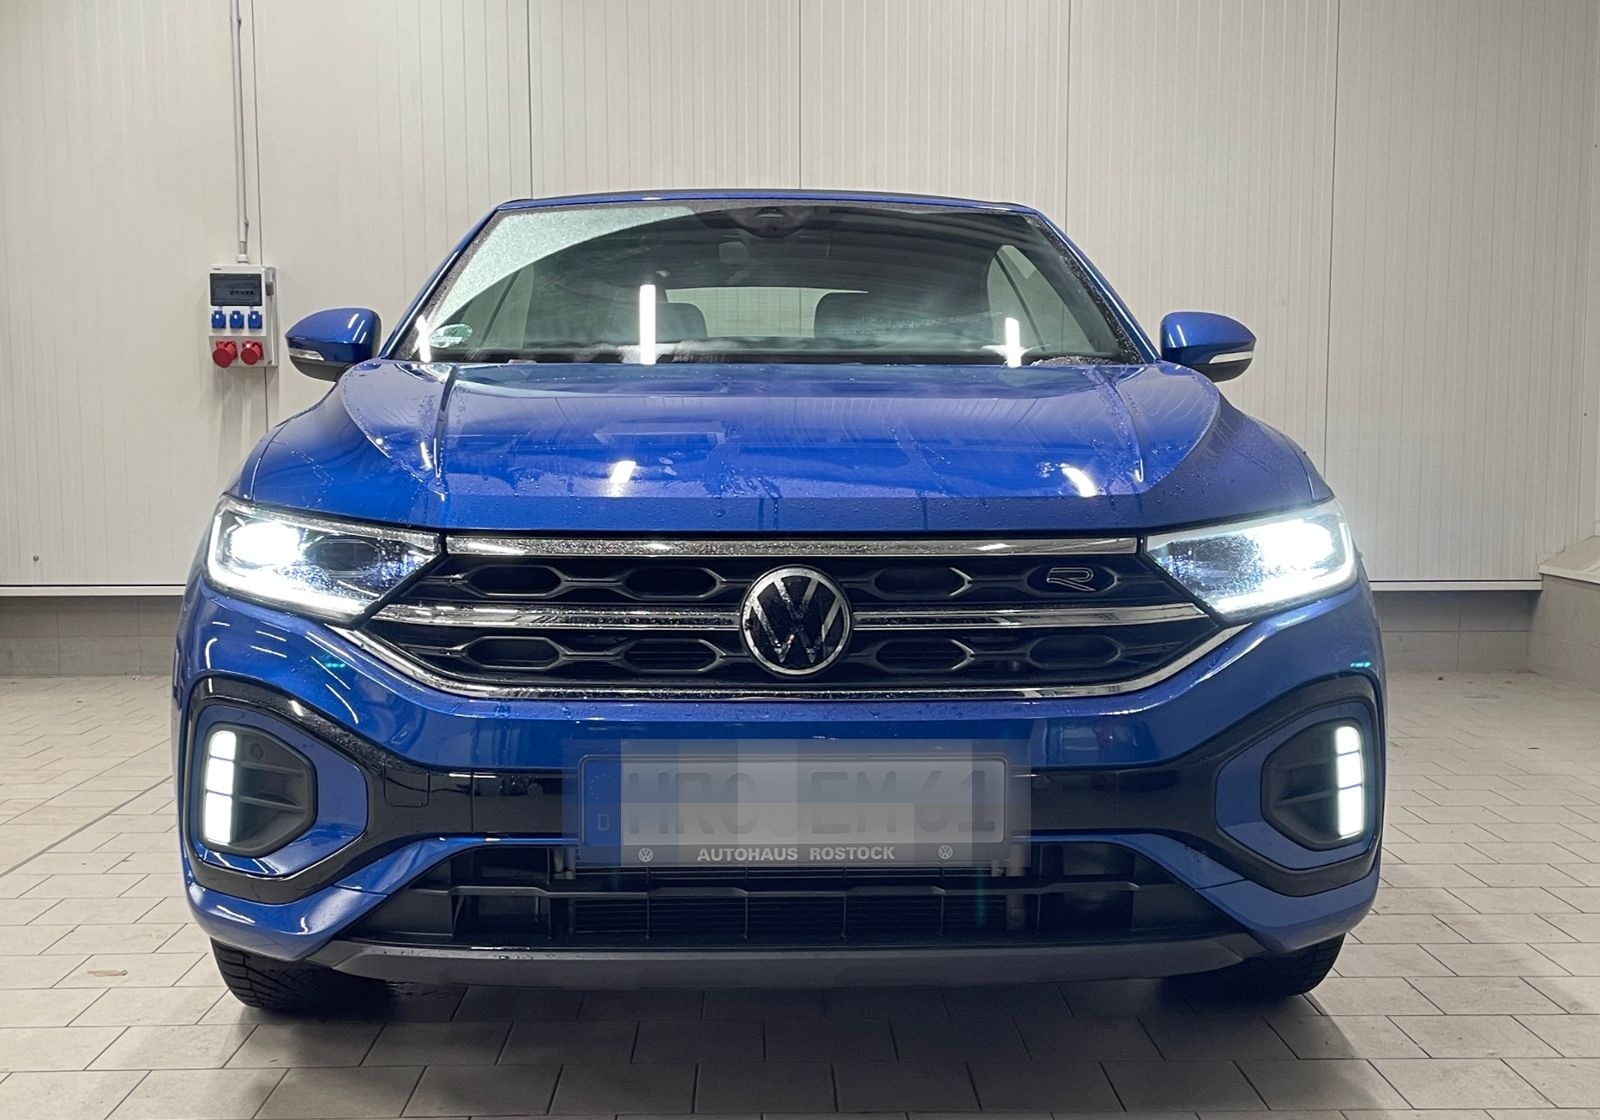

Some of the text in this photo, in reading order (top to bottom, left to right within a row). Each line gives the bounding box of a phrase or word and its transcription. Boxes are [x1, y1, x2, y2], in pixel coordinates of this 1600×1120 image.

[1046, 567, 1096, 591] R
[628, 771, 760, 835] HRO
[915, 770, 995, 833] 61
[597, 813, 610, 831] D
[697, 846, 895, 861] AUTOHAUS ROSTOCK
